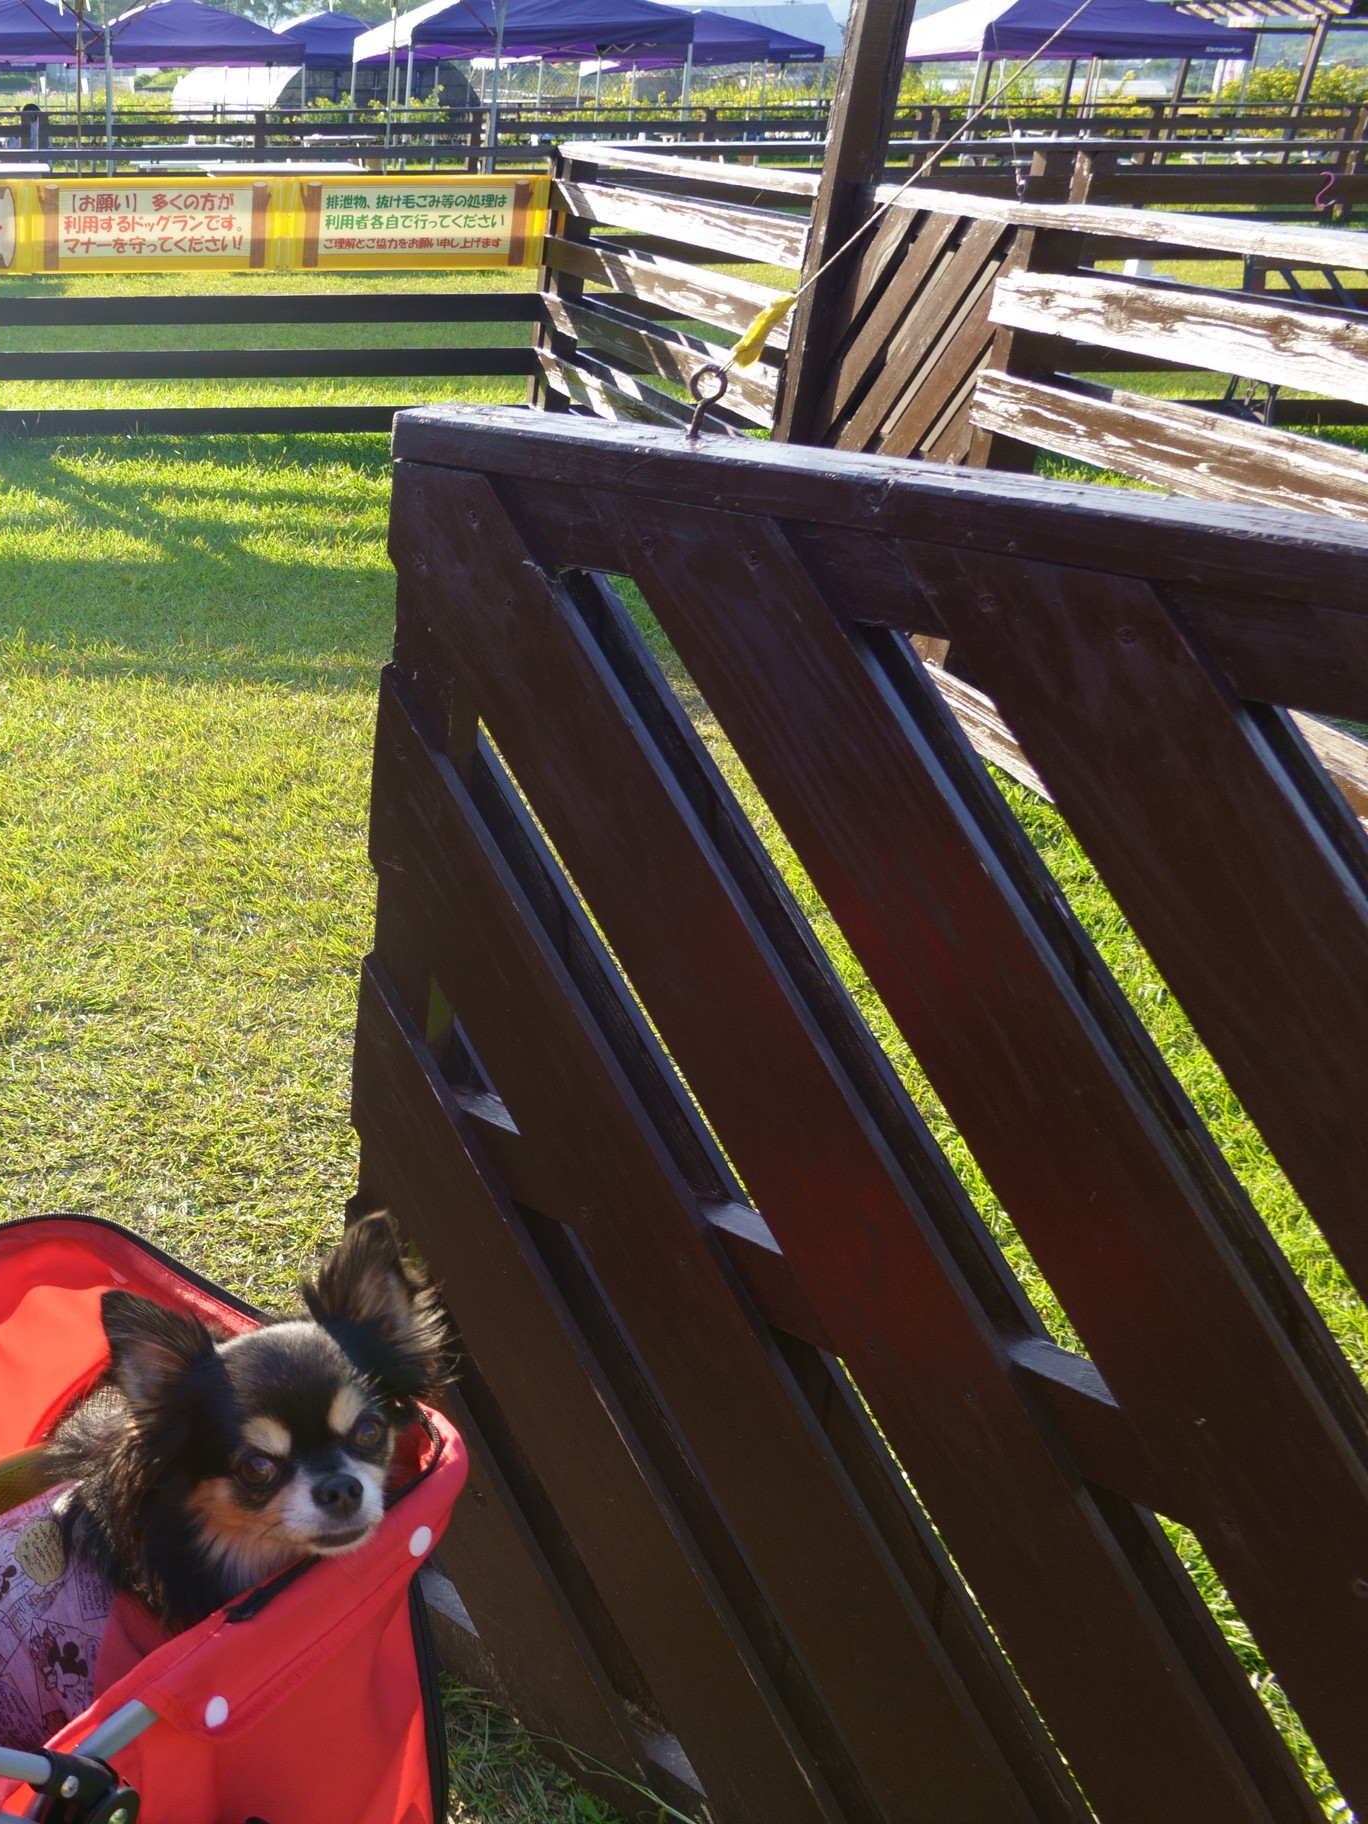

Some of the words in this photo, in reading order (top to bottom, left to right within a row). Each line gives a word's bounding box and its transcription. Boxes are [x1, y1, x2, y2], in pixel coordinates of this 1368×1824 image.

[151, 192, 234, 212] 多くの方が
[325, 193, 507, 210] 排泄物、抜け毛ごみ等の処理は
[63, 214, 242, 234] 利用するドッグランです。
[324, 214, 505, 231] 利用者各自で行ってください
[322, 237, 503, 251] ご理解とご協力をお願い申し上げます
